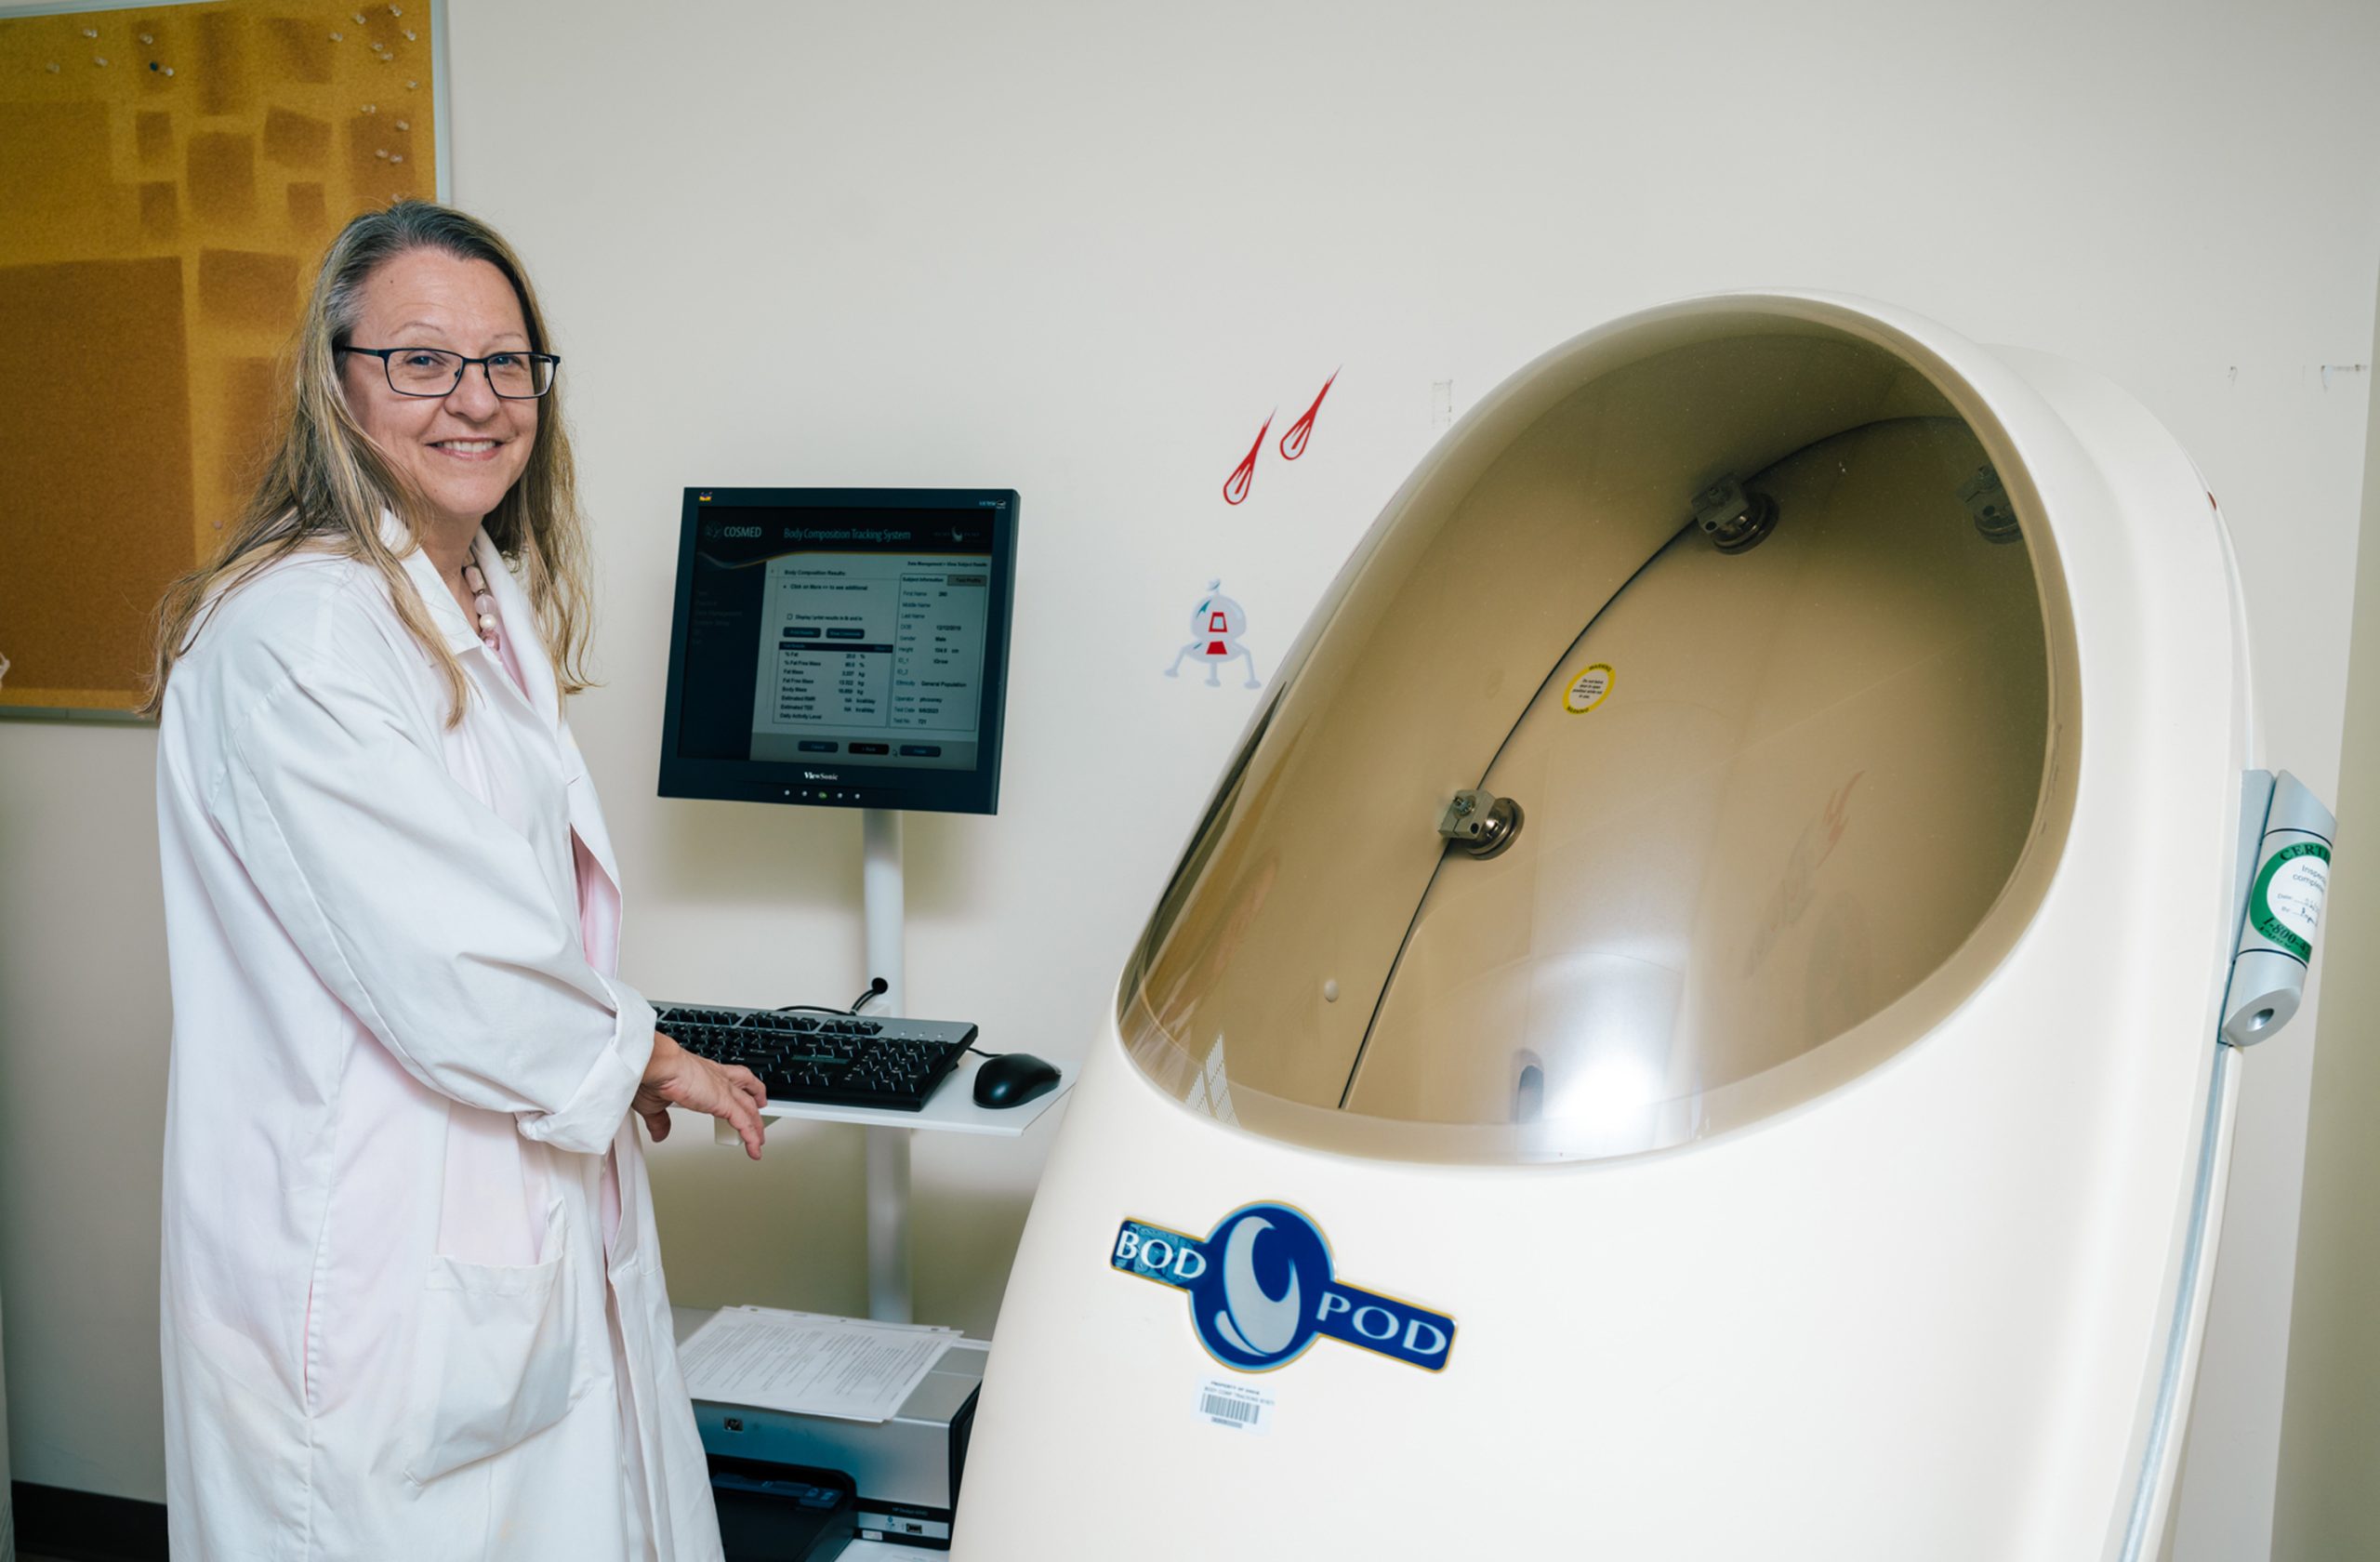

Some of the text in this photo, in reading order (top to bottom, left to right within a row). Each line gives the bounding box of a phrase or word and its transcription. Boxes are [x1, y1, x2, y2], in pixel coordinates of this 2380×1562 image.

[724, 526, 761, 537] COSMED
[784, 528, 911, 542] Body Composition Tracking System
[804, 772, 839, 780] ViewSonic
[2280, 844, 2330, 862] CERTI
[1116, 1230, 1207, 1278] BOD
[1316, 1291, 1447, 1355] POD
